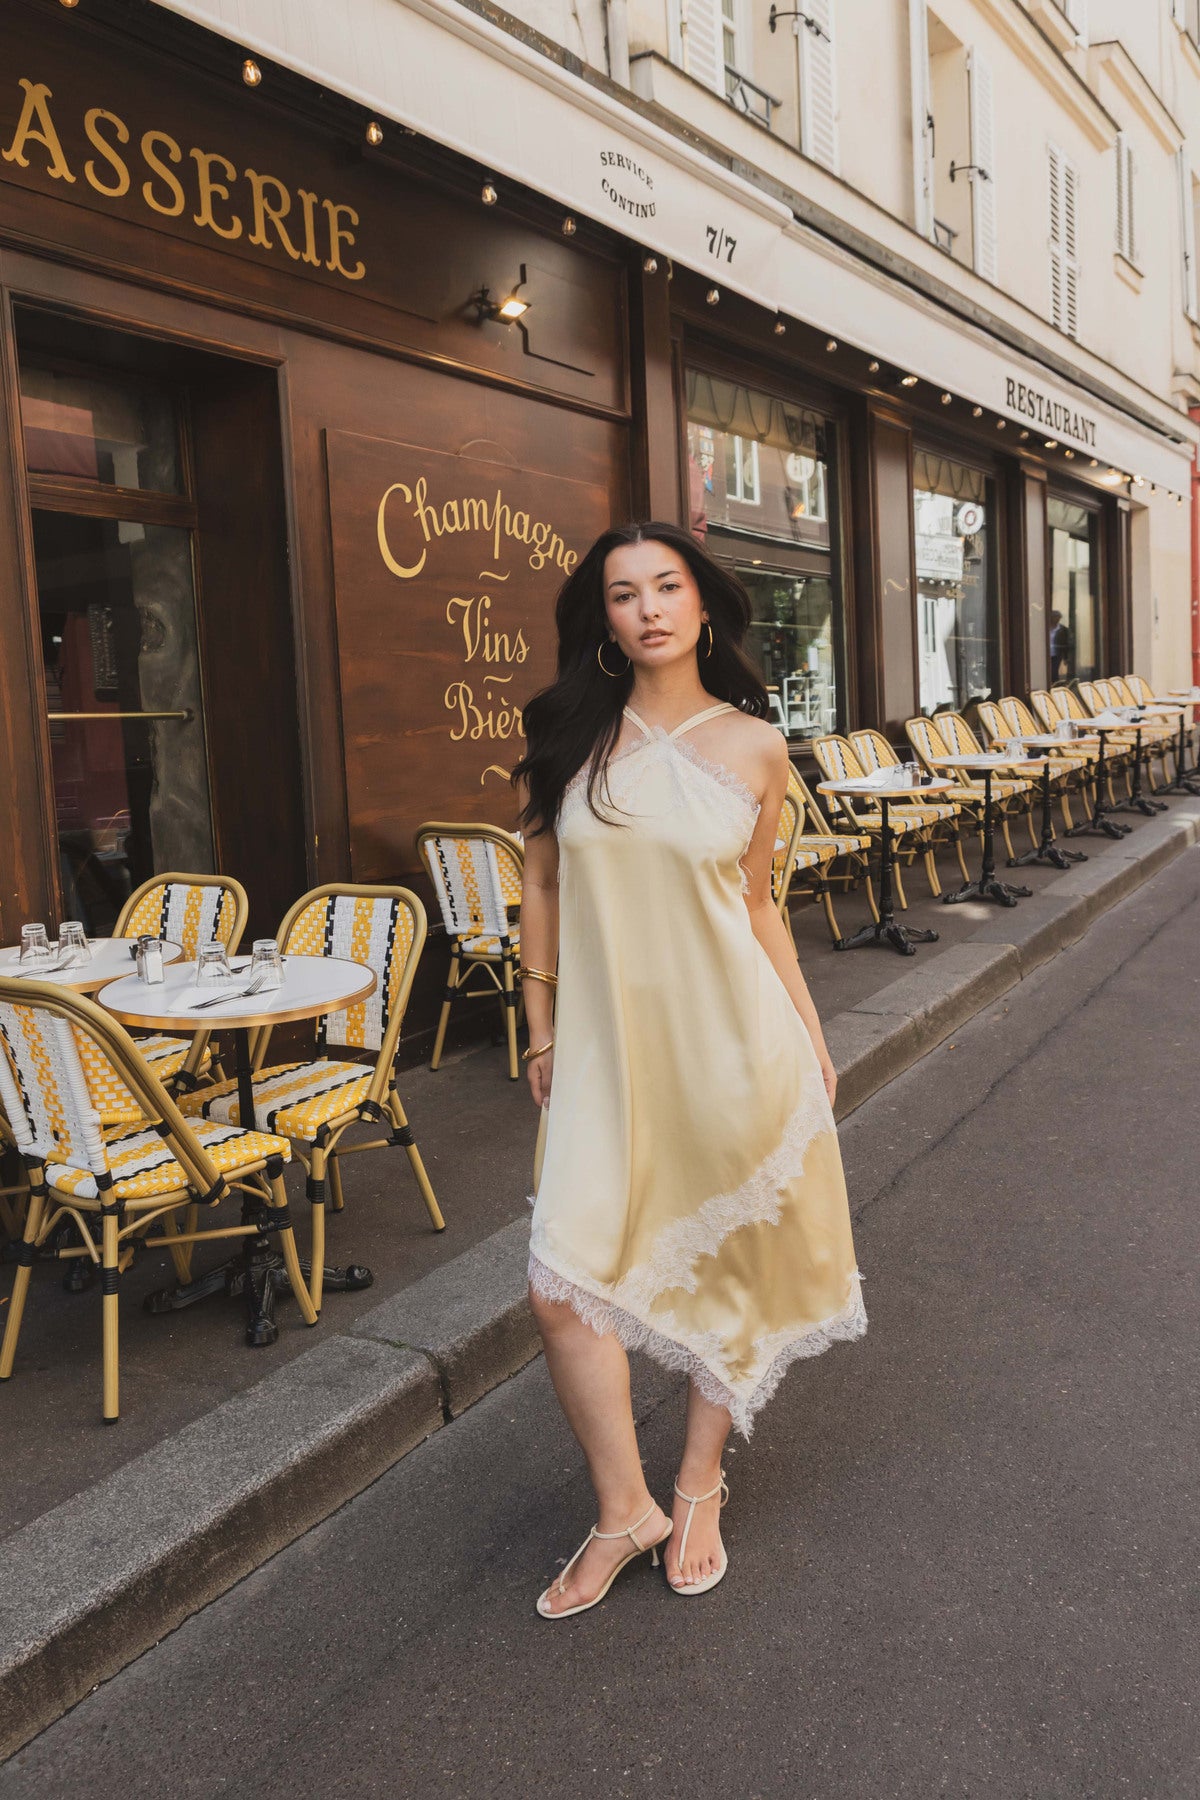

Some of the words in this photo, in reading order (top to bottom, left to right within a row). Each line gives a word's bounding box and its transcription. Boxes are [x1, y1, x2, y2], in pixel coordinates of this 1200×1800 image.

[1, 78, 366, 280] ASSERIE
[600, 151, 654, 190] SERVICE
[601, 178, 657, 219] CONTINU
[705, 225, 737, 263] 7/7
[1005, 377, 1096, 447] RESTAURANT
[377, 476, 578, 579] Champagne
[446, 595, 530, 663] Vins
